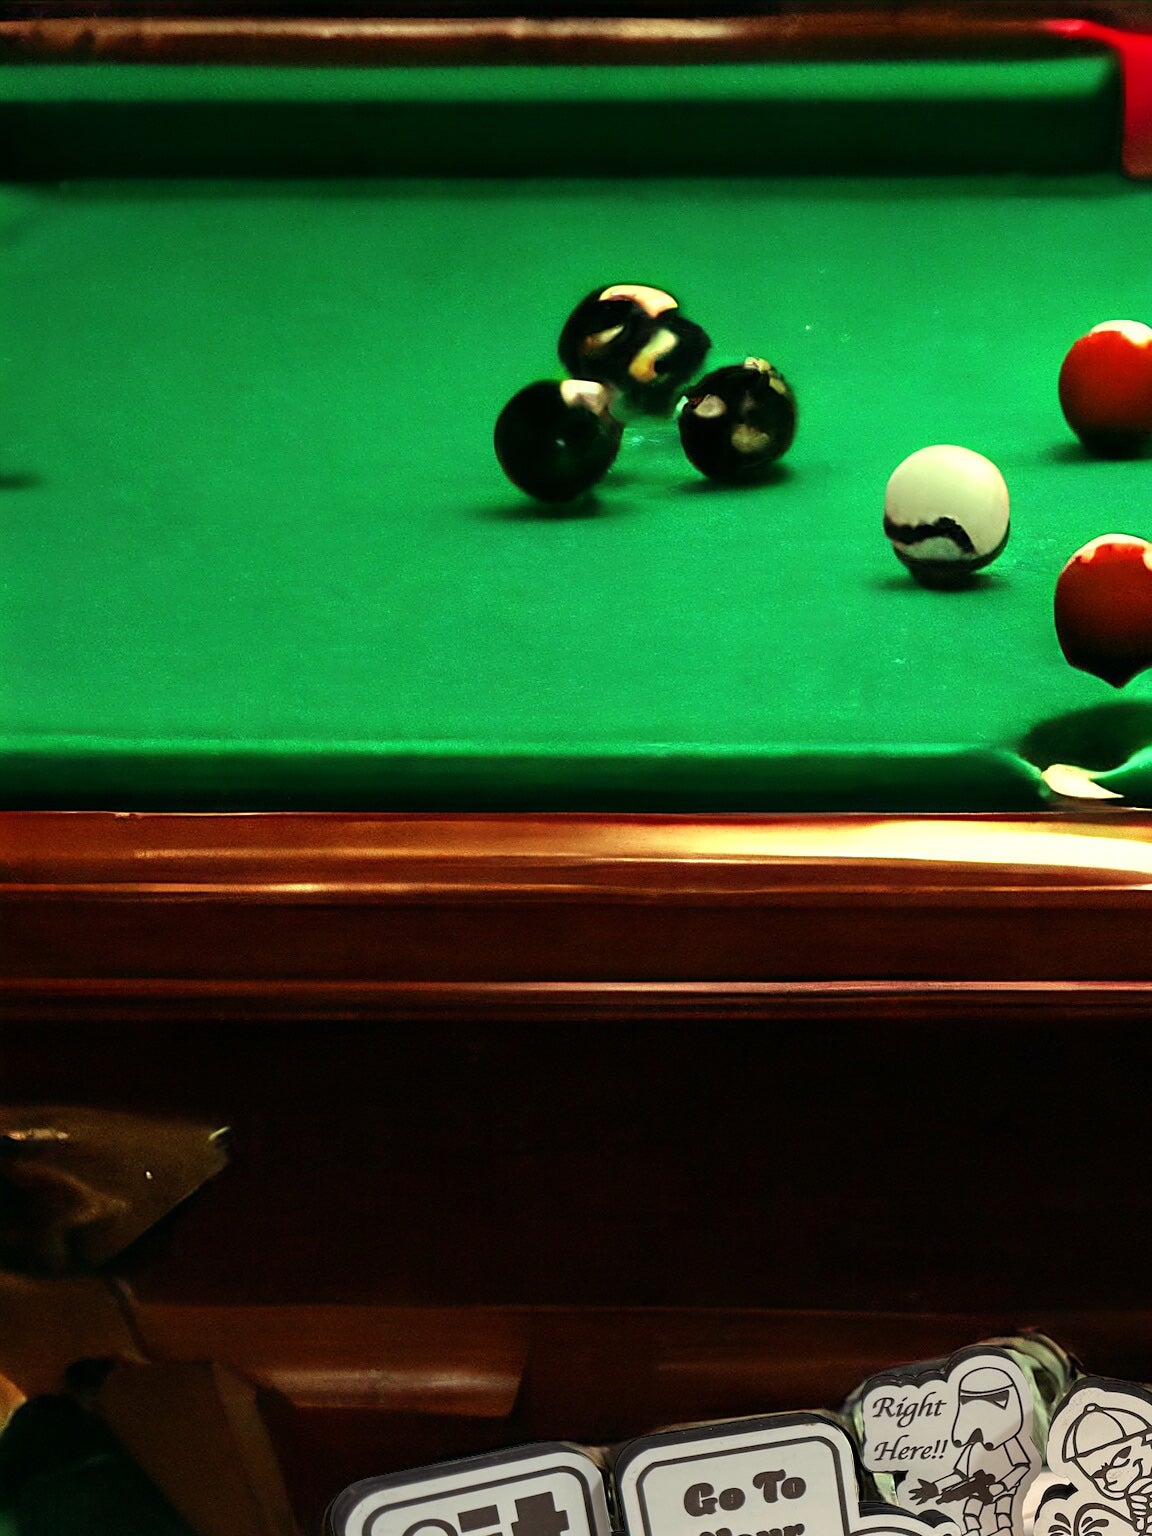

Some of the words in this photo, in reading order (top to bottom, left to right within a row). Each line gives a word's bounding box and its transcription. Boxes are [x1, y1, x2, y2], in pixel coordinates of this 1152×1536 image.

[872, 1397, 948, 1428] Right
[873, 1439, 948, 1462] Here!!
[683, 1482, 746, 1518] Go
[752, 1468, 807, 1506] To
